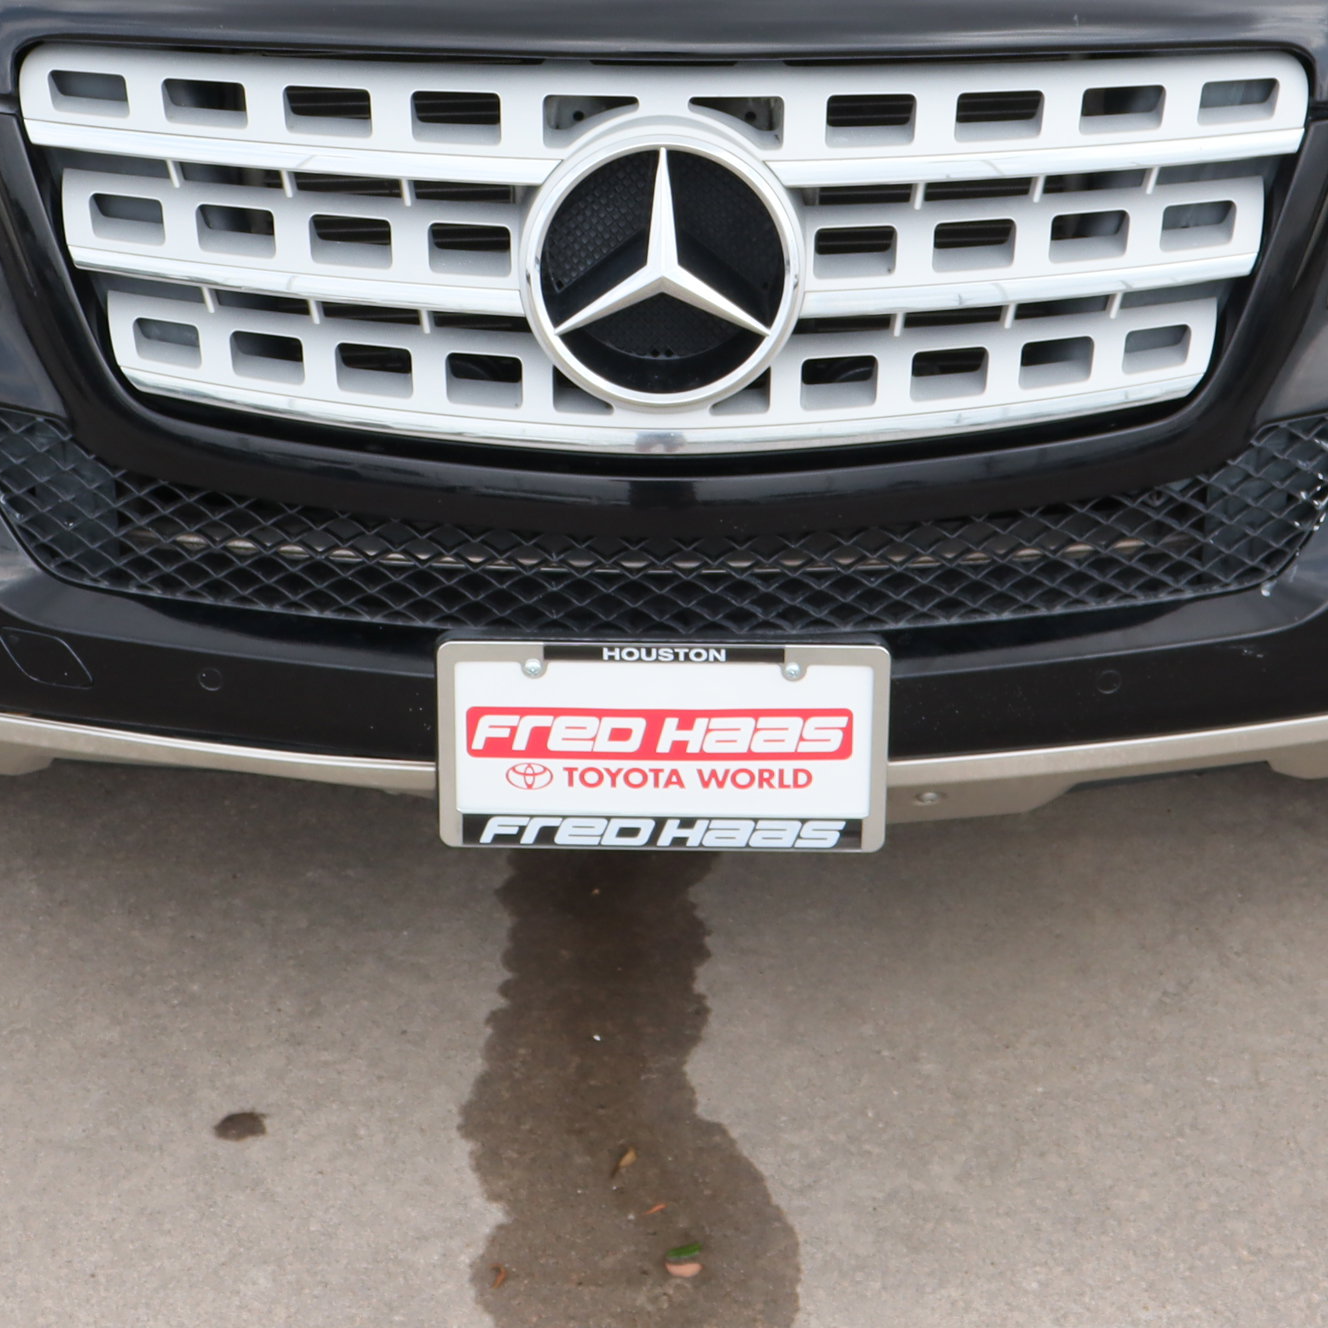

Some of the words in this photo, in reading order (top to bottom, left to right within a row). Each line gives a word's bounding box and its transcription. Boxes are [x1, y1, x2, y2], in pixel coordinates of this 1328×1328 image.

[602, 646, 726, 663] HOUSTON
[562, 767, 686, 789] TOYOTA
[697, 768, 813, 790] WORLD
